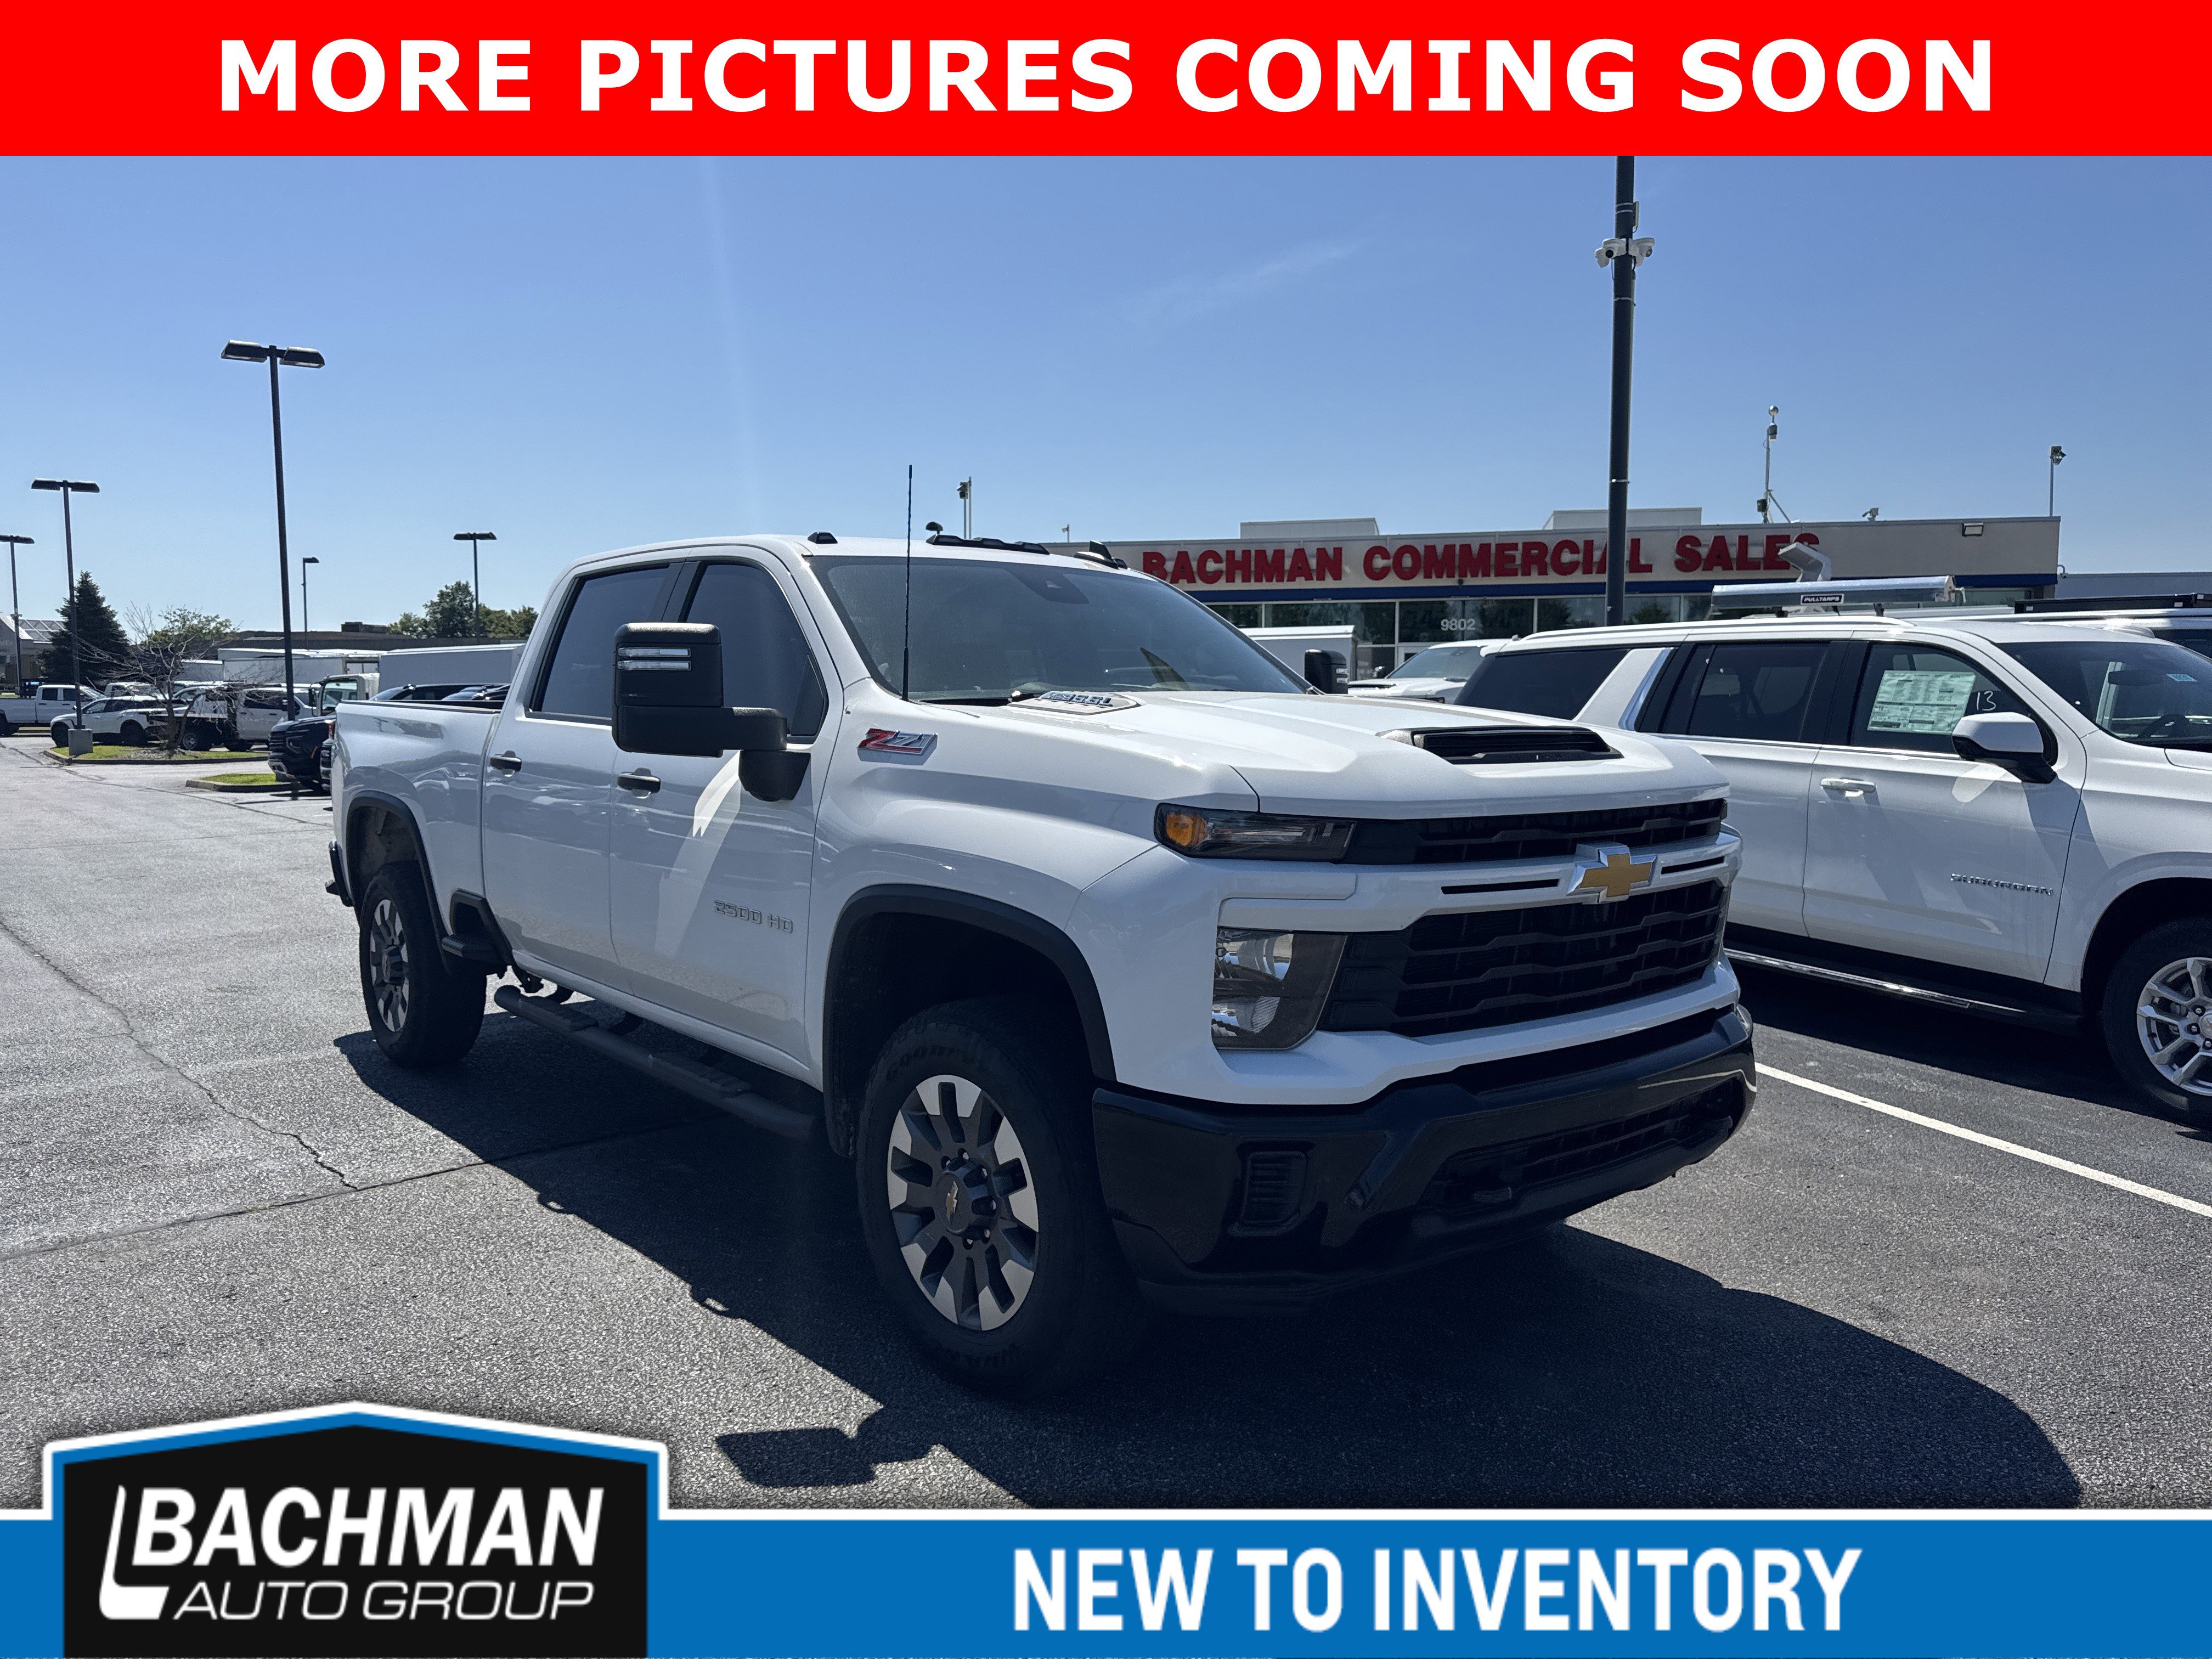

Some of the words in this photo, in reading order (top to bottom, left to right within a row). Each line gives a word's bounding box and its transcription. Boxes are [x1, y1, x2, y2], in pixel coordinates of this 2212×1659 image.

[1143, 547, 1342, 584] BACHMAN
[1441, 618, 1476, 631] 9802
[1976, 691, 1996, 711] 13
[856, 728, 938, 755] Z71
[714, 899, 762, 924] 2500
[768, 913, 793, 933] HD
